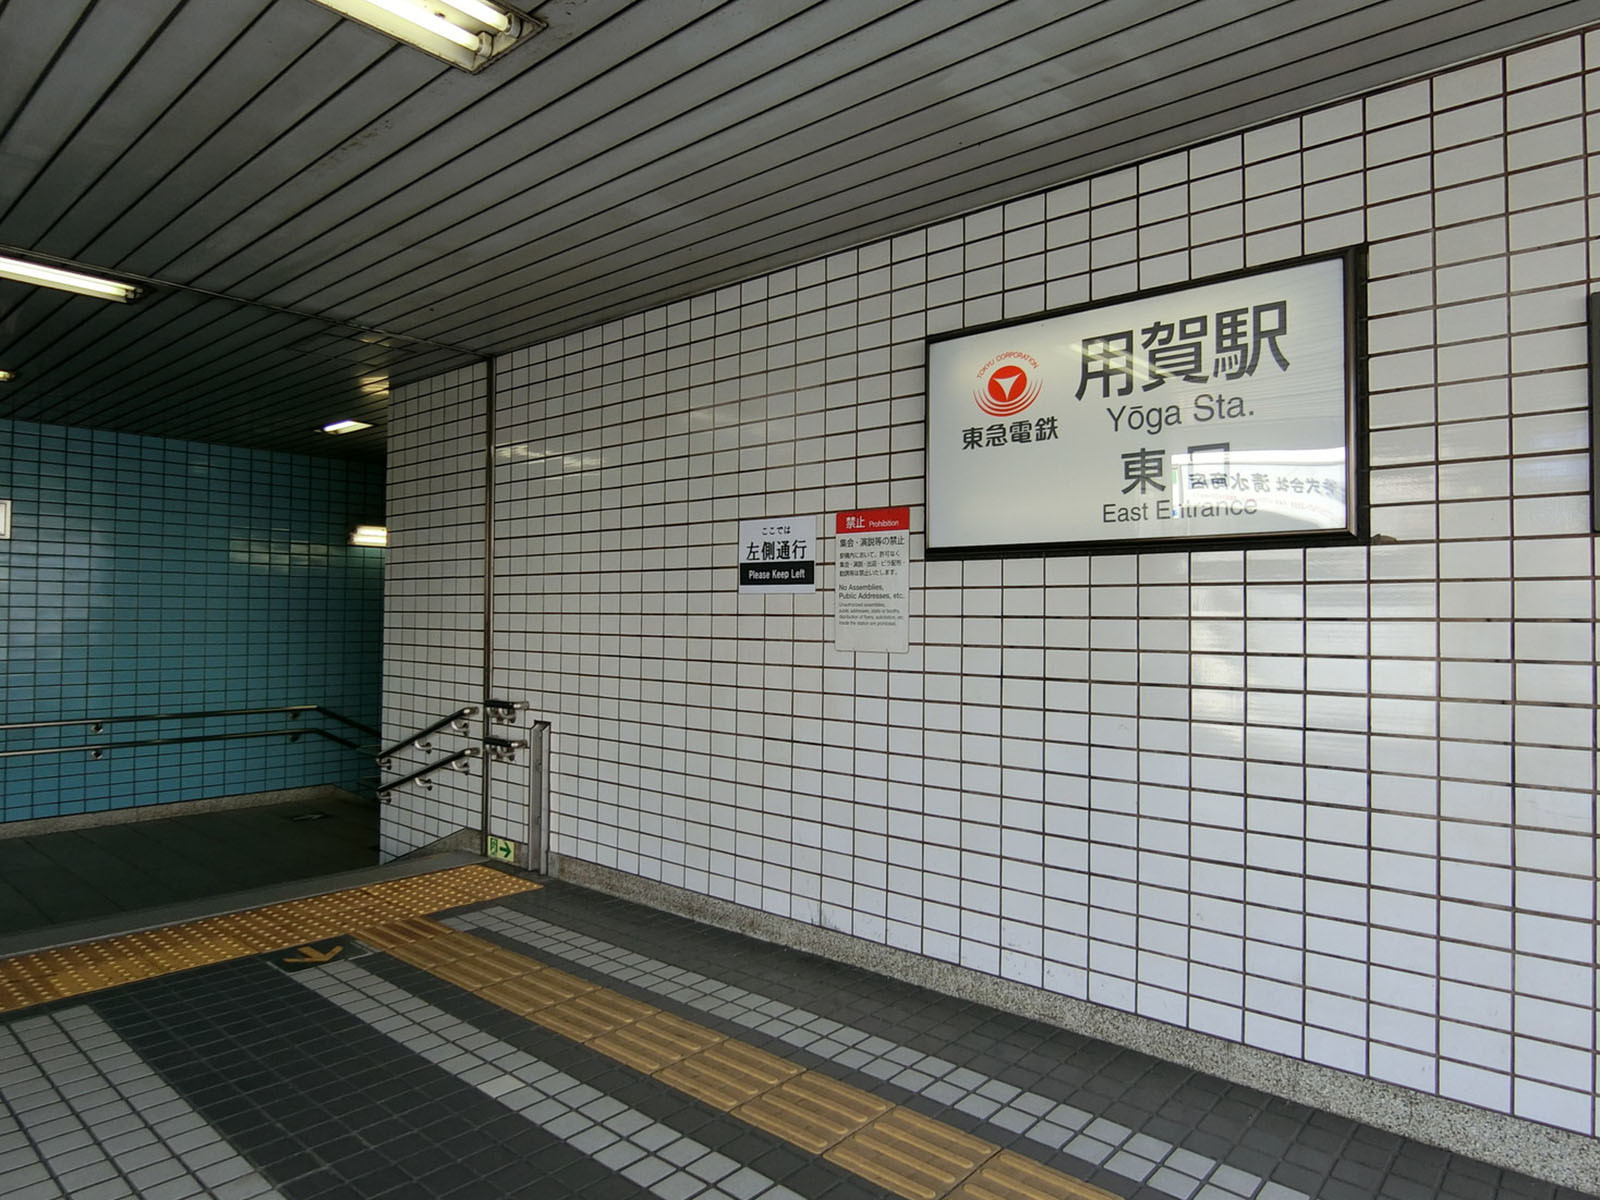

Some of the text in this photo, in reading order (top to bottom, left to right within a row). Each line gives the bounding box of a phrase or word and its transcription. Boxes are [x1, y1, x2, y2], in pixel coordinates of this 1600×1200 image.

[1075, 300, 1291, 402] 用賀駅
[976, 351, 1040, 380] TOKYU CORPORATION
[1106, 393, 1256, 436] Yōga Sta.
[961, 416, 1060, 451] 東急電鉄
[845, 516, 900, 529] 禁止 Prohibition
[1103, 502, 1149, 524] East
[761, 526, 792, 536] ここでは
[746, 539, 808, 562] 左側通行
[748, 567, 806, 581] Please Keep Left
[838, 592, 857, 600] Public
[858, 592, 892, 600] Addresses,
